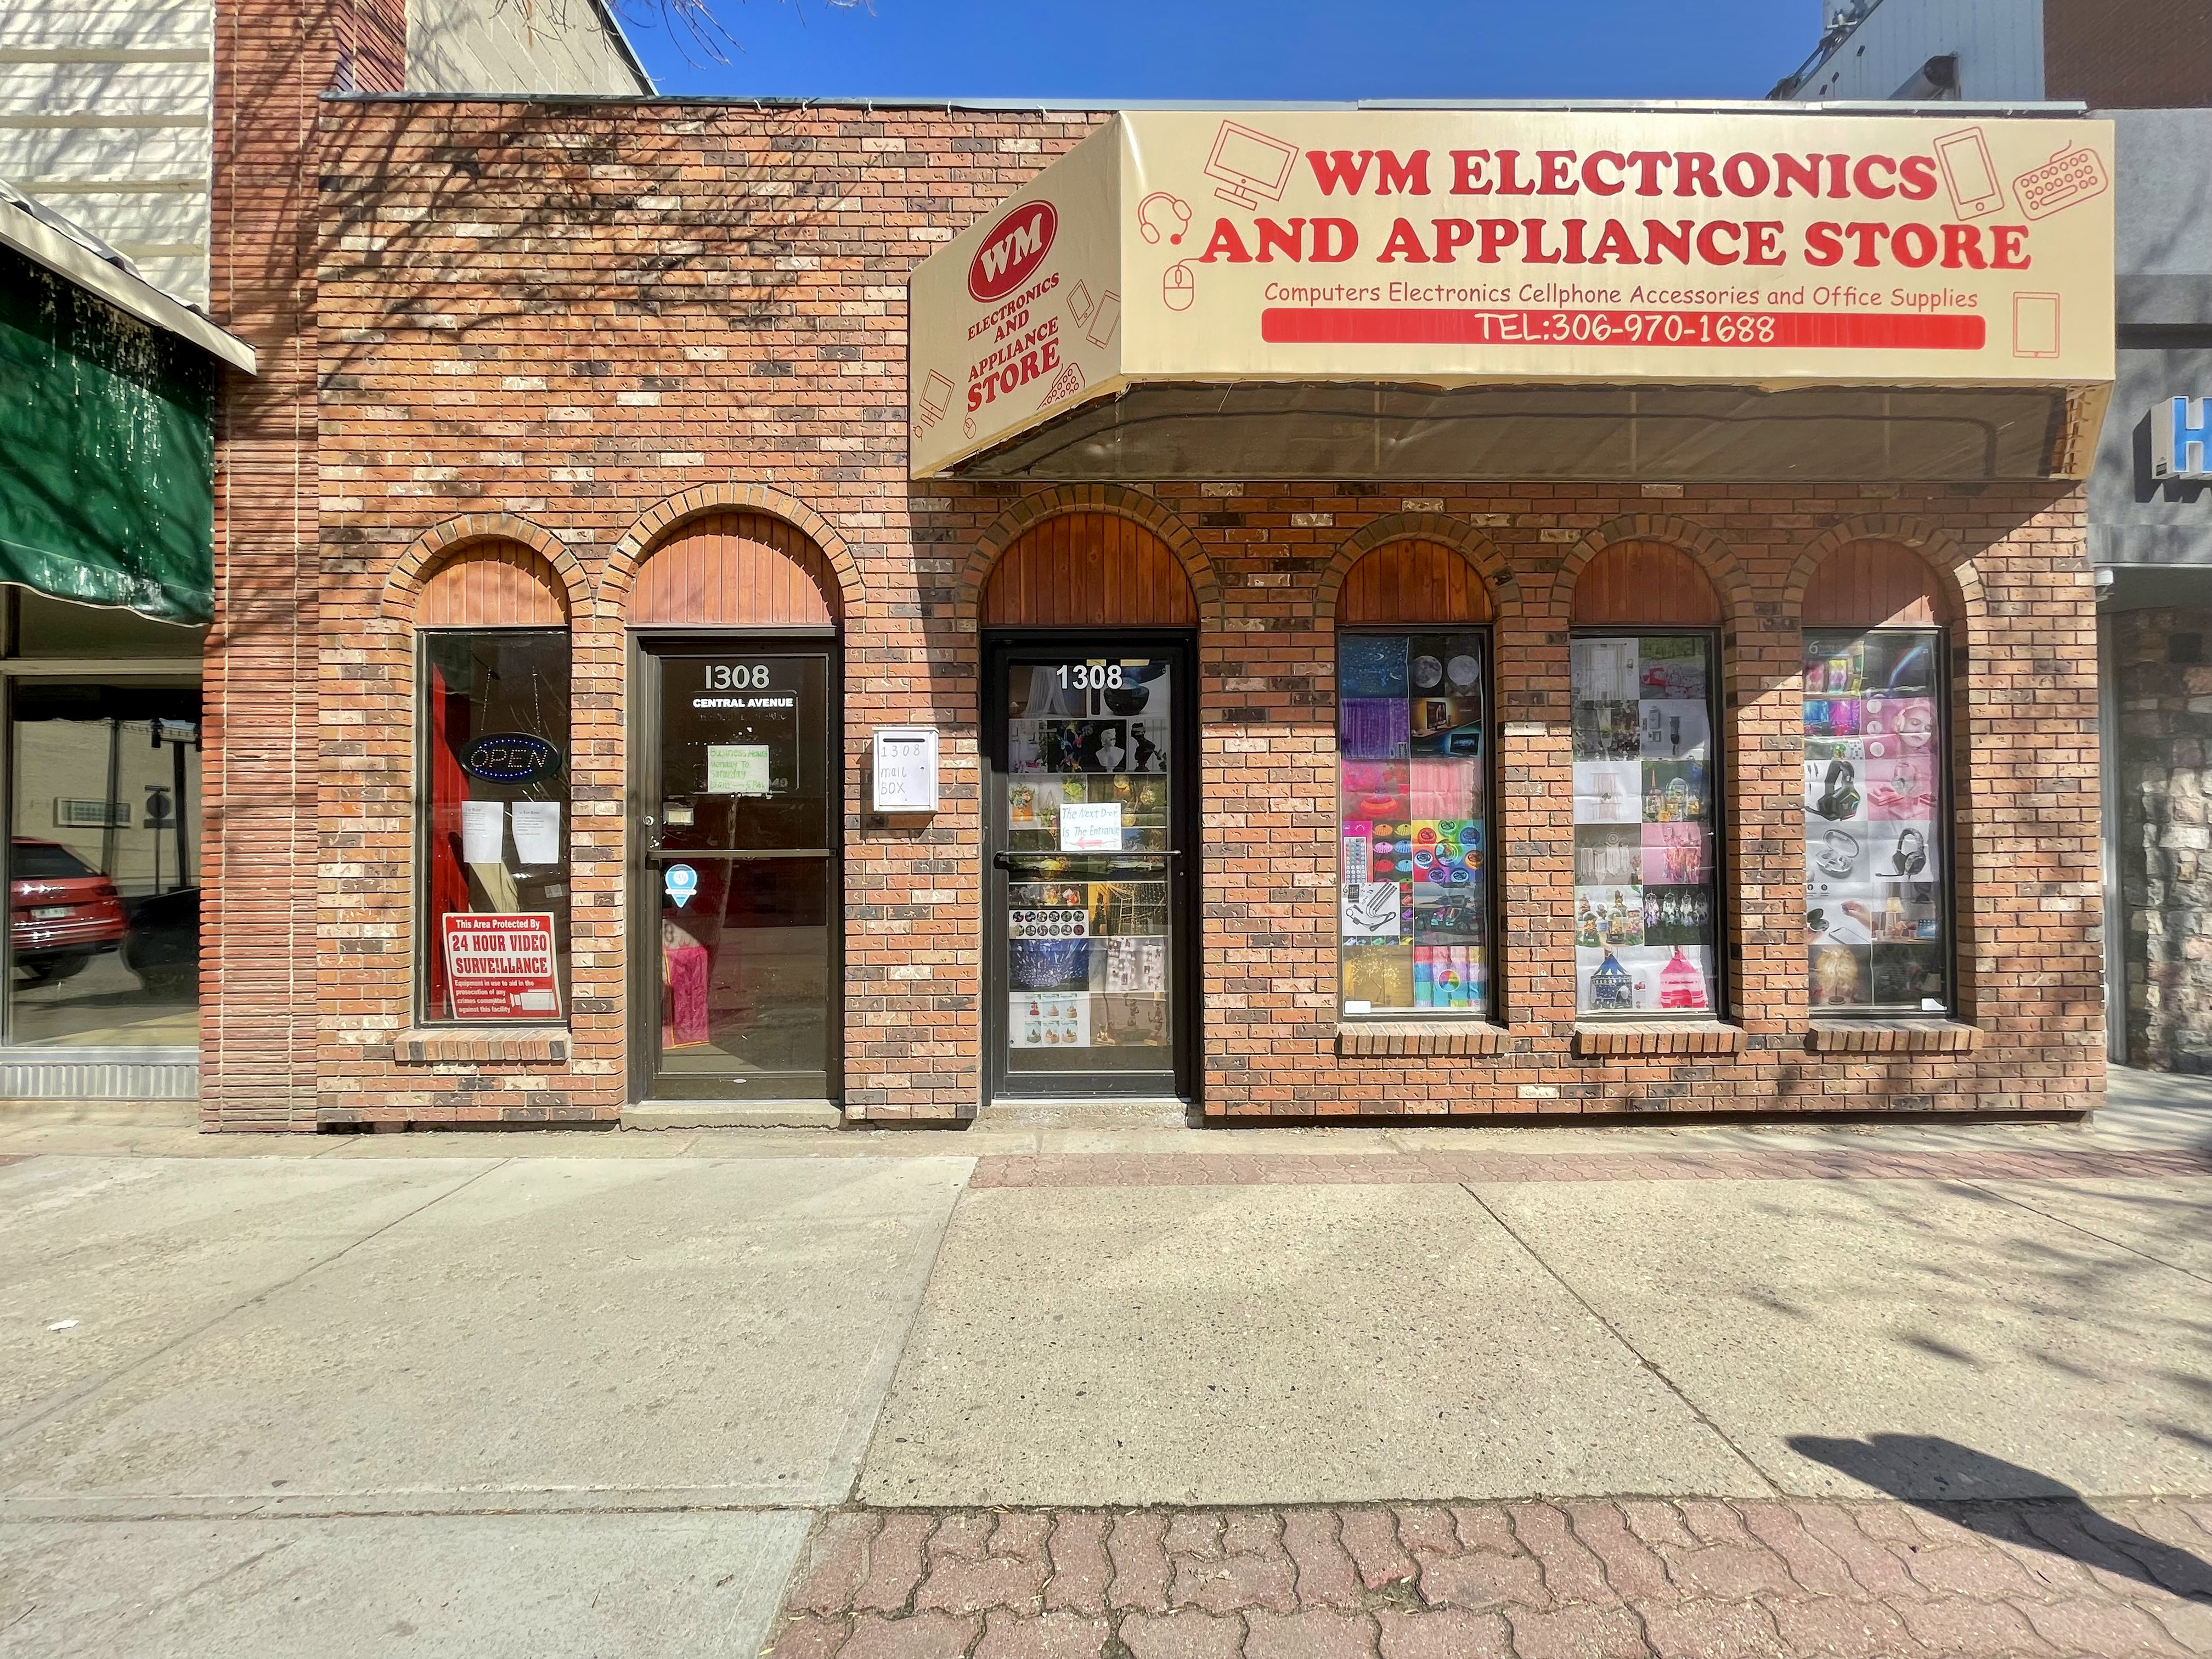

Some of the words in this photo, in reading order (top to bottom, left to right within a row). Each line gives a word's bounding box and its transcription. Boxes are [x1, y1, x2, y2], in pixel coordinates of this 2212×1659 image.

[1305, 149, 1431, 196] WM
[1448, 149, 1938, 201] ELECTRONICS
[980, 212, 1043, 283] WM
[1198, 217, 1359, 263] AND
[1376, 217, 1787, 266] APPLIANCE
[1803, 221, 2032, 270] STORE
[967, 272, 1059, 341] ELECTRONICS
[1264, 281, 1381, 307] Computers
[1389, 281, 1511, 303] Electronics
[1518, 283, 1621, 308] Cellphone
[1629, 285, 1759, 305] Accessories
[1767, 286, 1804, 305] and
[1813, 286, 1881, 307] Office
[1891, 288, 1978, 313] Supplies
[994, 309, 1029, 344] AND
[1473, 312, 1776, 343] TEL:306-970-1688
[967, 315, 1059, 383] APPLIANCE
[967, 337, 1060, 413] STORE
[1809, 640, 1819, 654] 6
[706, 664, 770, 689] 1308
[1056, 664, 1123, 689] 1308
[692, 698, 746, 708] CENTRAL
[747, 698, 794, 708] AVENUE
[470, 749, 549, 768] OPEN
[881, 782, 905, 795] BOX
[1062, 807, 1077, 819] The
[1079, 808, 1099, 818] Next
[1062, 826, 1070, 837] Is
[1074, 826, 1087, 837] The
[1090, 825, 1120, 836] Entrance
[455, 919, 472, 929] This
[473, 919, 490, 929] Area
[492, 919, 528, 929] Protected
[530, 918, 540, 930] By
[452, 935, 469, 951] 24
[472, 934, 506, 951] HOUR
[509, 934, 547, 952] VIDEO
